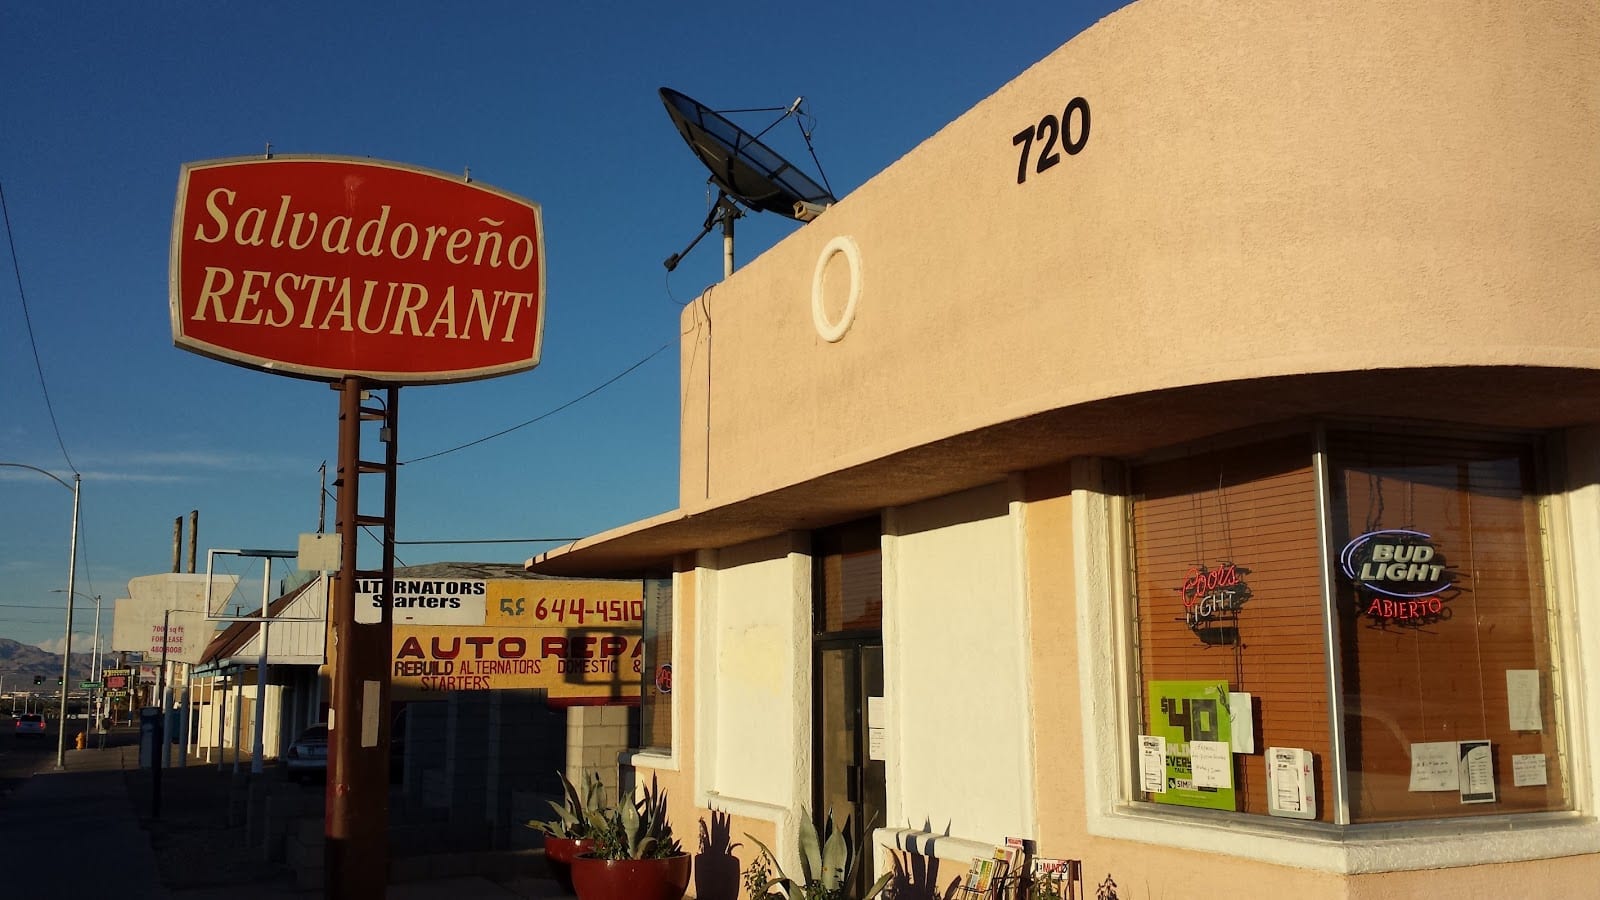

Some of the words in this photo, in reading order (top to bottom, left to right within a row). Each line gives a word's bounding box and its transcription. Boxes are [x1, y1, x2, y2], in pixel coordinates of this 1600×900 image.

[1013, 97, 1091, 184] 720
[194, 188, 534, 270] Salvadoreño
[191, 266, 533, 343] RESTAURANT
[1372, 544, 1434, 562] BUD
[1360, 563, 1446, 581] LIGHT
[354, 581, 485, 595] ALTRNATORS
[372, 594, 461, 608] Sarters
[535, 597, 642, 624] 644-4510
[1367, 598, 1442, 619] ABIERTO
[396, 636, 527, 659] AUTO
[394, 660, 454, 676] REBUILD
[459, 660, 541, 675] ALTERNATORS
[557, 660, 618, 674] DOMESTIC
[420, 675, 491, 692] STARTERS
[1161, 696, 1219, 742] $40
